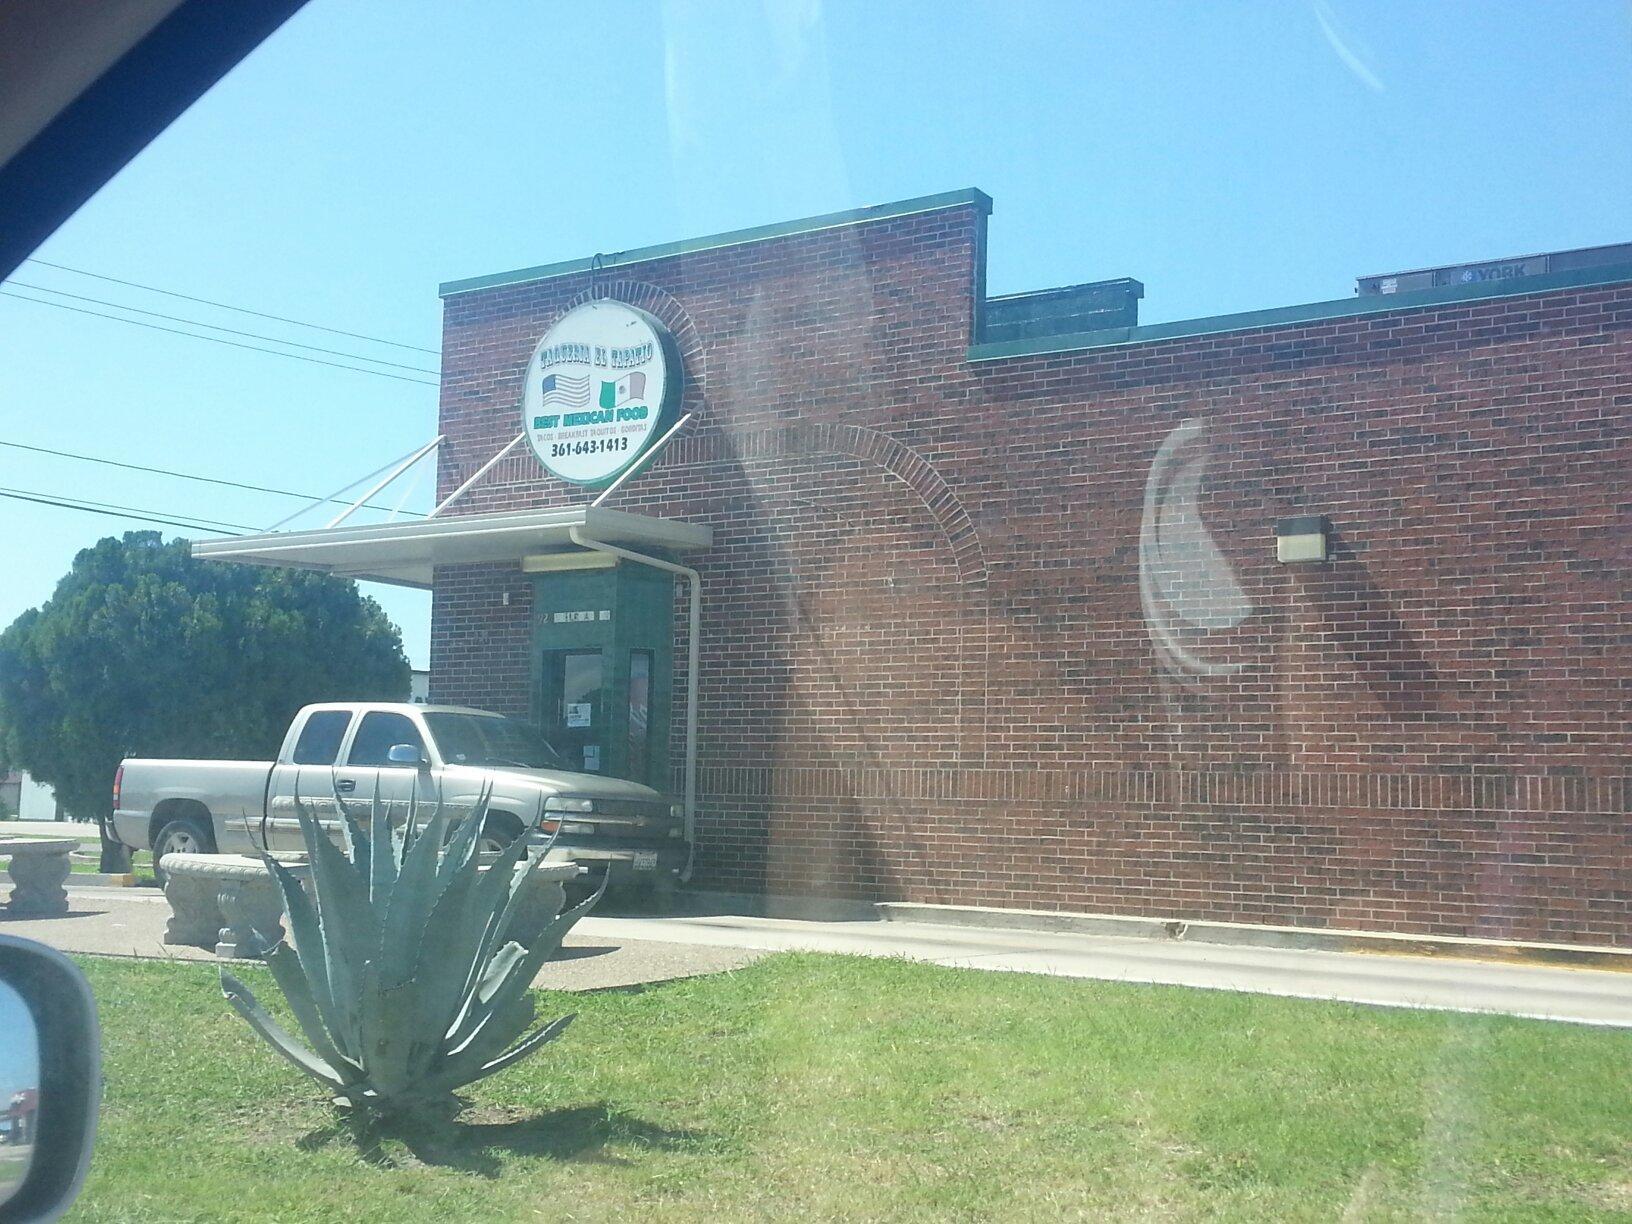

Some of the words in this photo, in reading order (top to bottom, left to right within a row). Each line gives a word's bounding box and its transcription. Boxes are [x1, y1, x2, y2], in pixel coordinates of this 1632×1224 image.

[1477, 263, 1526, 281] YORK
[541, 344, 591, 369] TAQUERIA
[594, 346, 607, 367] EL
[611, 343, 653, 368] TAPATIO
[533, 415, 560, 429] BEST
[563, 410, 614, 427] MEXICAN
[616, 406, 648, 422] FOOD
[558, 430, 588, 440] BREAKFAST
[551, 437, 628, 457] 361-643-1413
